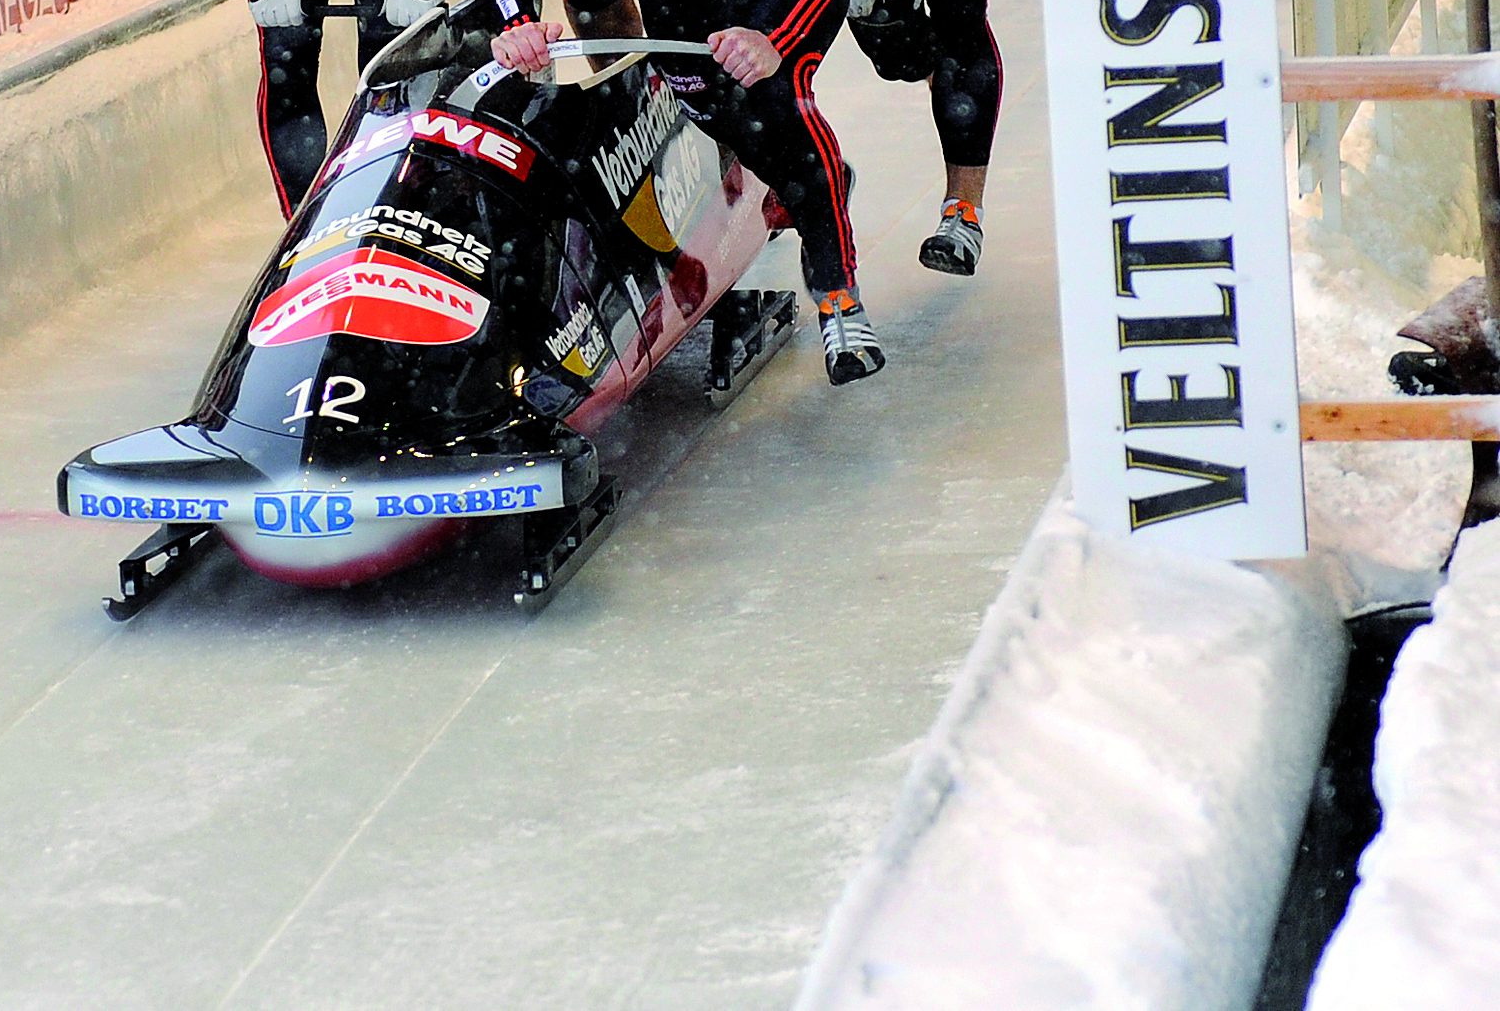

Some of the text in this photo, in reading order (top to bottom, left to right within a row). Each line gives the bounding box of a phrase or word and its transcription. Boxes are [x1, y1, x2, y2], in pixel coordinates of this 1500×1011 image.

[323, 112, 523, 182] REWE
[279, 205, 492, 266] Verbundnetz
[345, 220, 486, 275] Gas AG
[259, 271, 475, 333] VIESSMANN
[282, 374, 367, 427] 12
[80, 483, 543, 535] BORBET DKB BORBET
